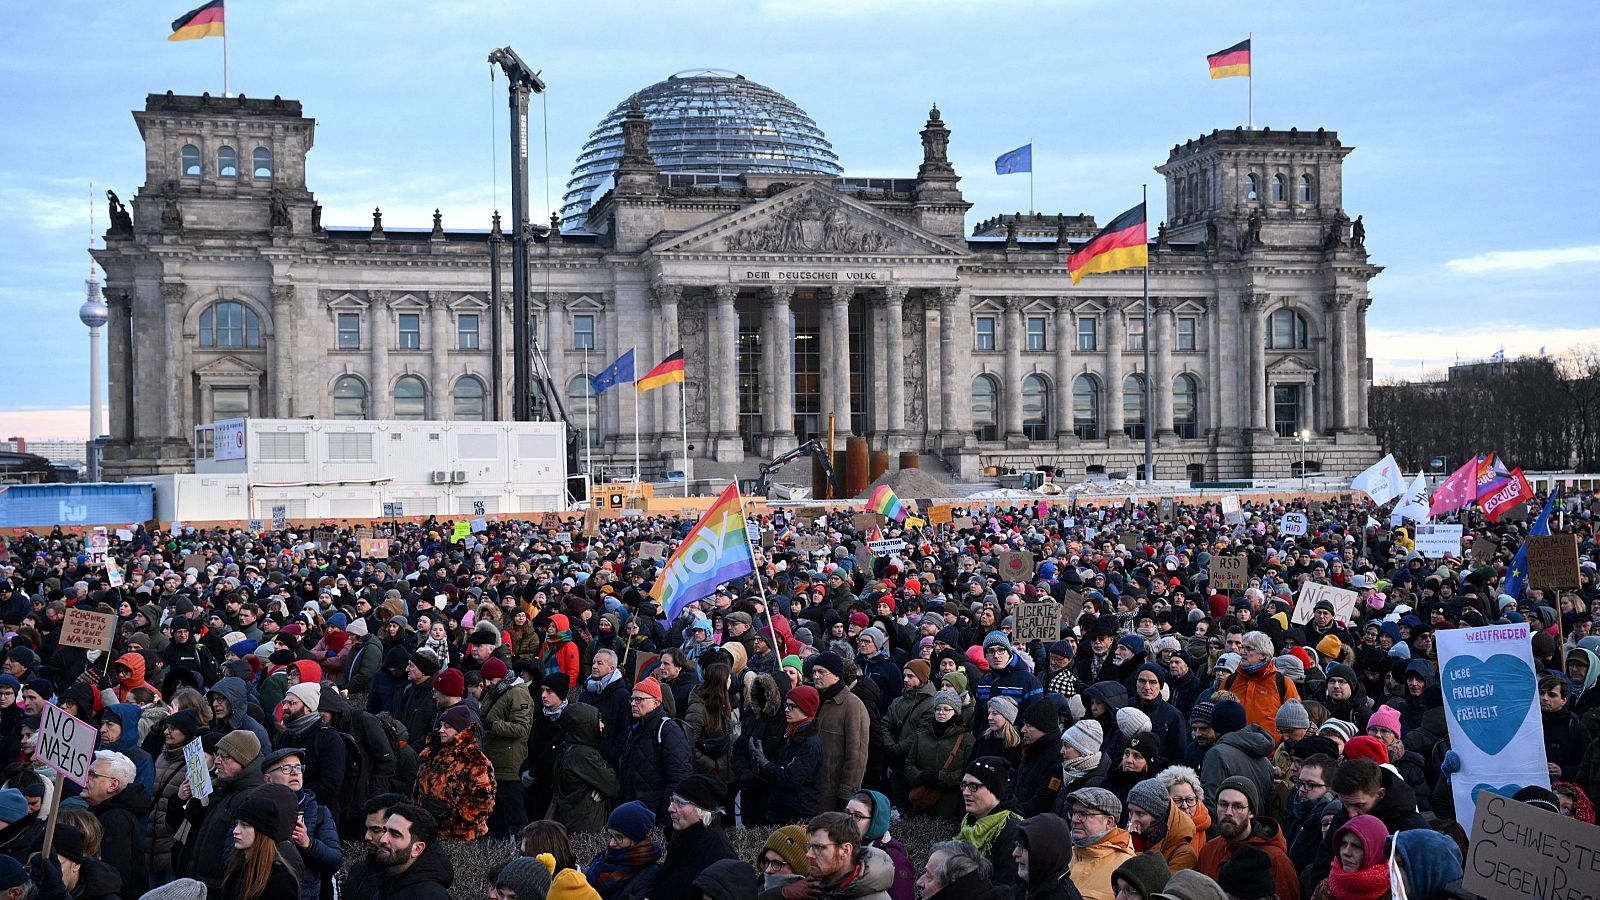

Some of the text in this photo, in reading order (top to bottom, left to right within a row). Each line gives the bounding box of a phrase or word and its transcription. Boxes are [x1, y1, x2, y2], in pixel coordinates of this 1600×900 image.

[746, 271, 877, 280] DEM DEUTSCHEN VOLKE
[70, 619, 106, 631] LEBEN
[73, 628, 102, 637] OHNE
[1465, 627, 1527, 641] WELTFRIEDEN
[66, 635, 102, 646] NAZIS
[1450, 667, 1471, 681] LIEBE
[1452, 684, 1494, 700] FRIEDEN
[1456, 705, 1498, 722] FREIHEIT
[44, 706, 75, 743] NO
[39, 733, 88, 778] NAZIS
